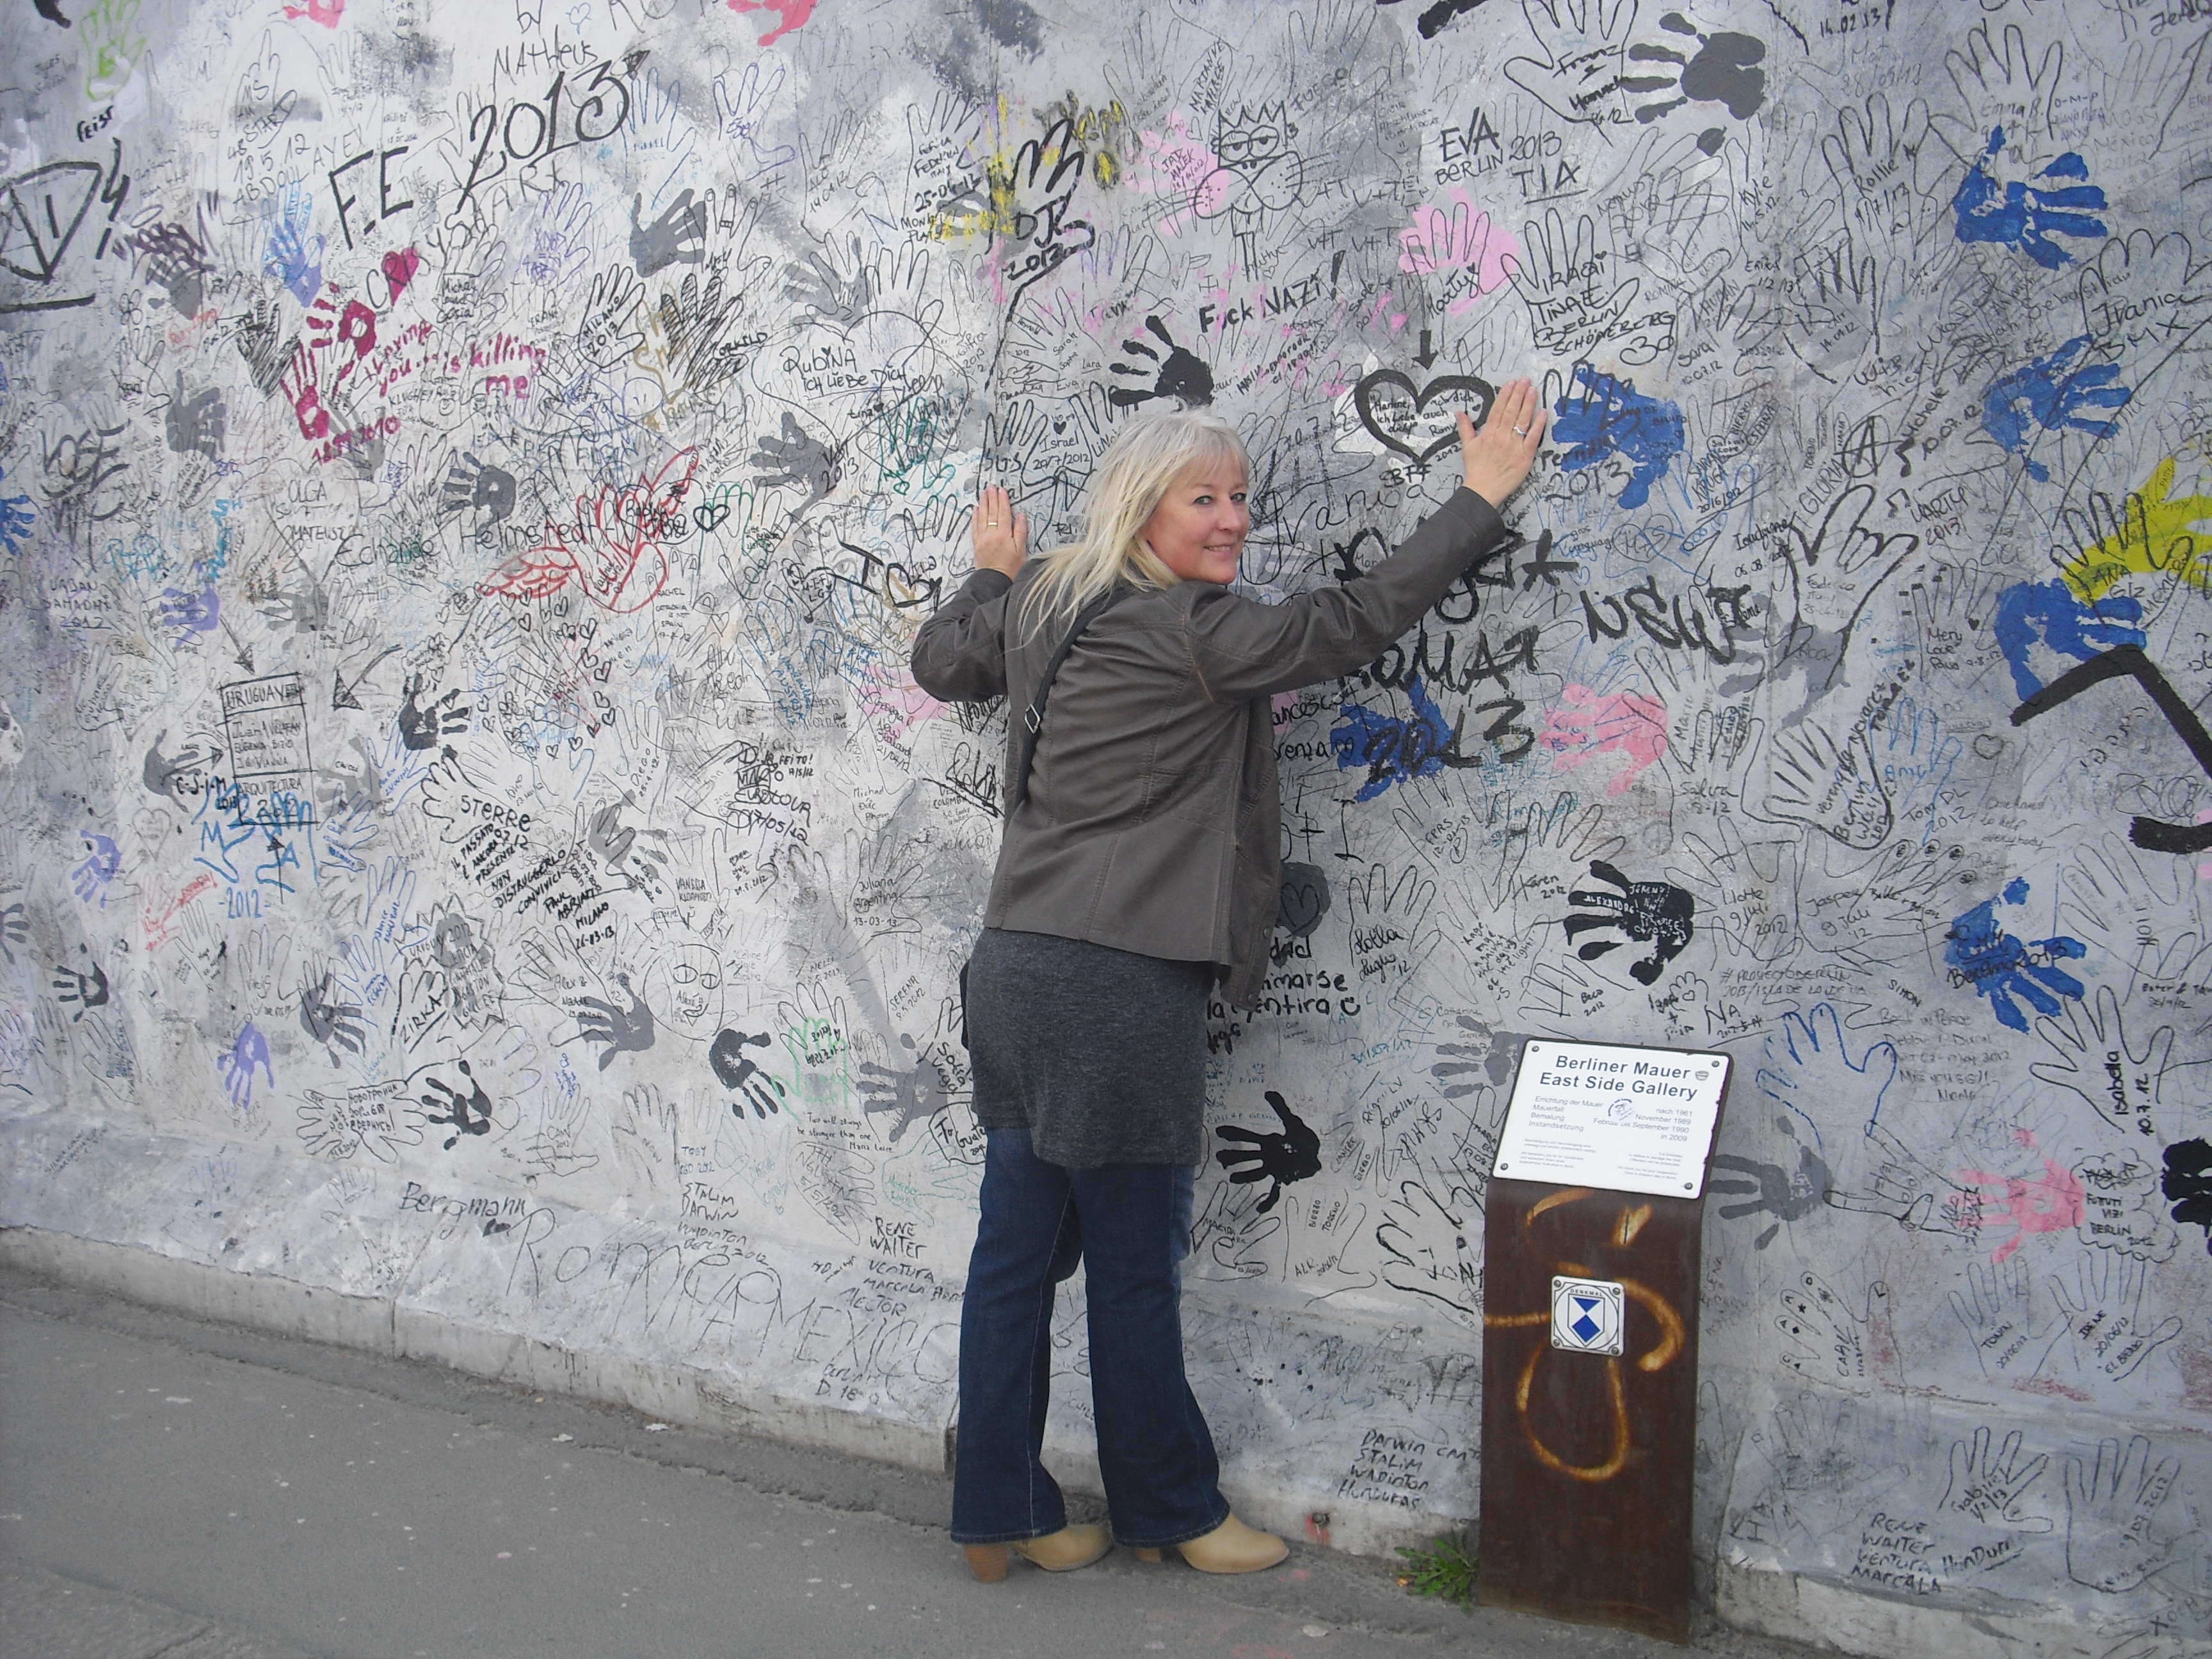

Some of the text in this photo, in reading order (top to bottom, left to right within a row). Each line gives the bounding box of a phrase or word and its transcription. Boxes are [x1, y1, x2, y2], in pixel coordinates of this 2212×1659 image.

[456, 59, 630, 214] 2013
[1441, 106, 1500, 163] EVA
[1510, 131, 1564, 161] 2013
[1512, 164, 1581, 198] TIA
[1556, 1055, 1691, 1079] Berliner Mauer
[1540, 1072, 1698, 1101] East Side Gallery
[1528, 1121, 1584, 1132] Instandsetzung
[1530, 1112, 1565, 1122] Bemalung
[1632, 1122, 1669, 1132] September
[1635, 1114, 1671, 1123] November
[1570, 1288, 1603, 1297] DENKMAL
